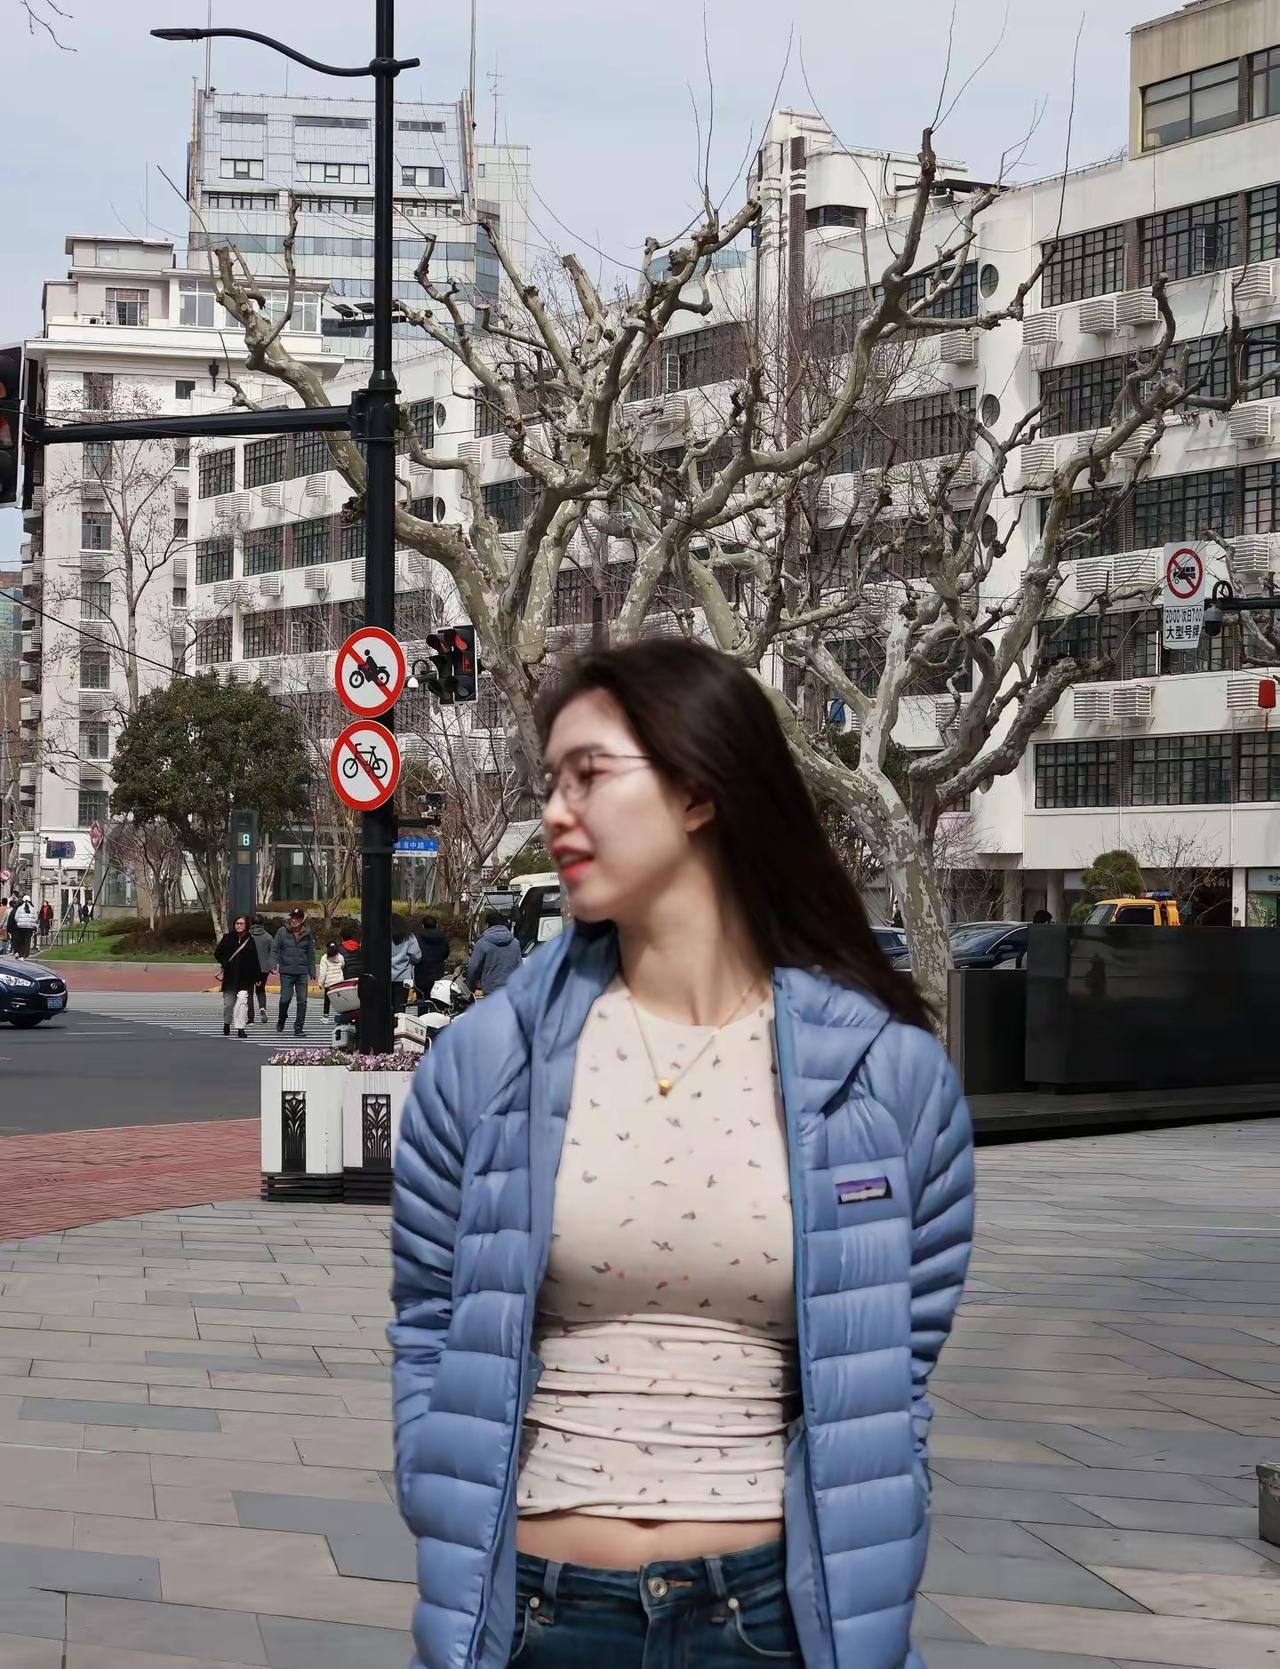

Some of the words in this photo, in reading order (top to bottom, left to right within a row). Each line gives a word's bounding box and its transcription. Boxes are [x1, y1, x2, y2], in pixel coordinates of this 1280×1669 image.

[1166, 625, 1200, 639] 大型号牌
[243, 834, 250, 846] 8
